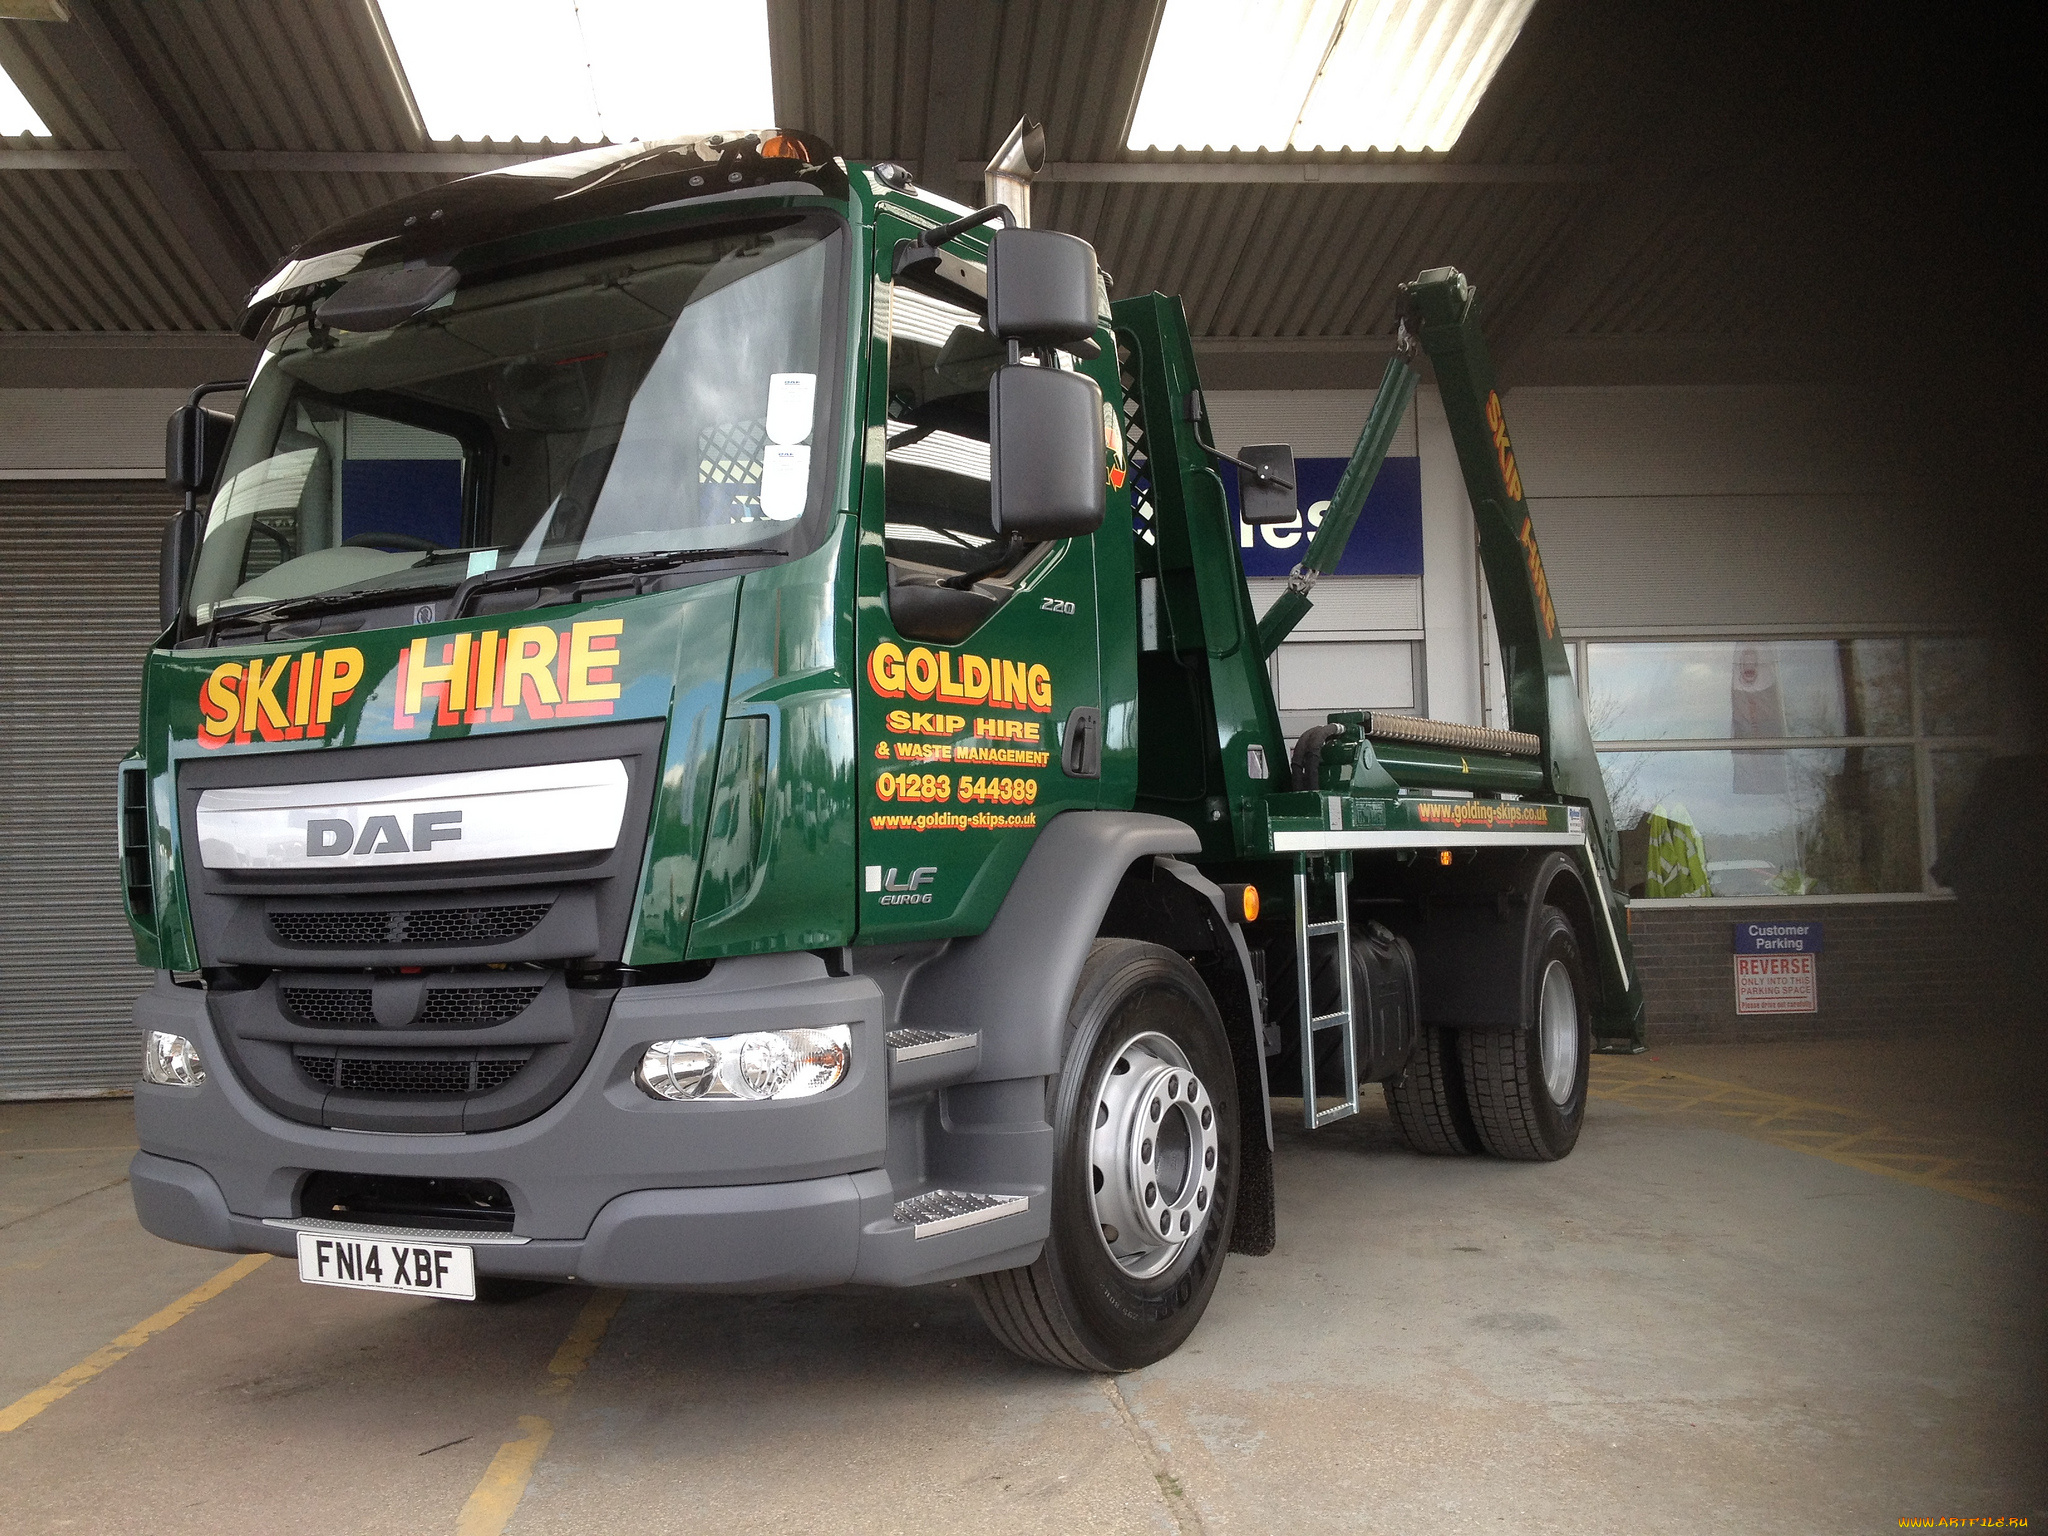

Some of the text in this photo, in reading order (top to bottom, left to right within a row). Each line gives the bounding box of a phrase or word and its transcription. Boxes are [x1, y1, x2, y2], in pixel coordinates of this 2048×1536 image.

[1486, 389, 1522, 501] SKIP
[1041, 597, 1076, 615] 220
[198, 618, 624, 750] SKIP HIRE
[867, 642, 1052, 713] GOLDING
[886, 710, 1040, 743] SKIP HIRE
[875, 741, 1050, 768] & WASTE MANAGEMENT
[876, 772, 1038, 804] 01283 544389
[870, 812, 1037, 832] www.golding-skips.co.uk
[1417, 801, 1548, 828] www.golding-skips.co.uk
[306, 810, 463, 857] DAF
[884, 866, 938, 892] LF
[1748, 925, 1810, 936] Customer
[1756, 938, 1804, 951] Parking
[1740, 958, 1810, 975] REVERSE
[1741, 976, 1811, 986] ONLY INTO THIS
[1741, 985, 1811, 995] PARKING SPACE
[316, 1240, 453, 1289] FN14 XBF
